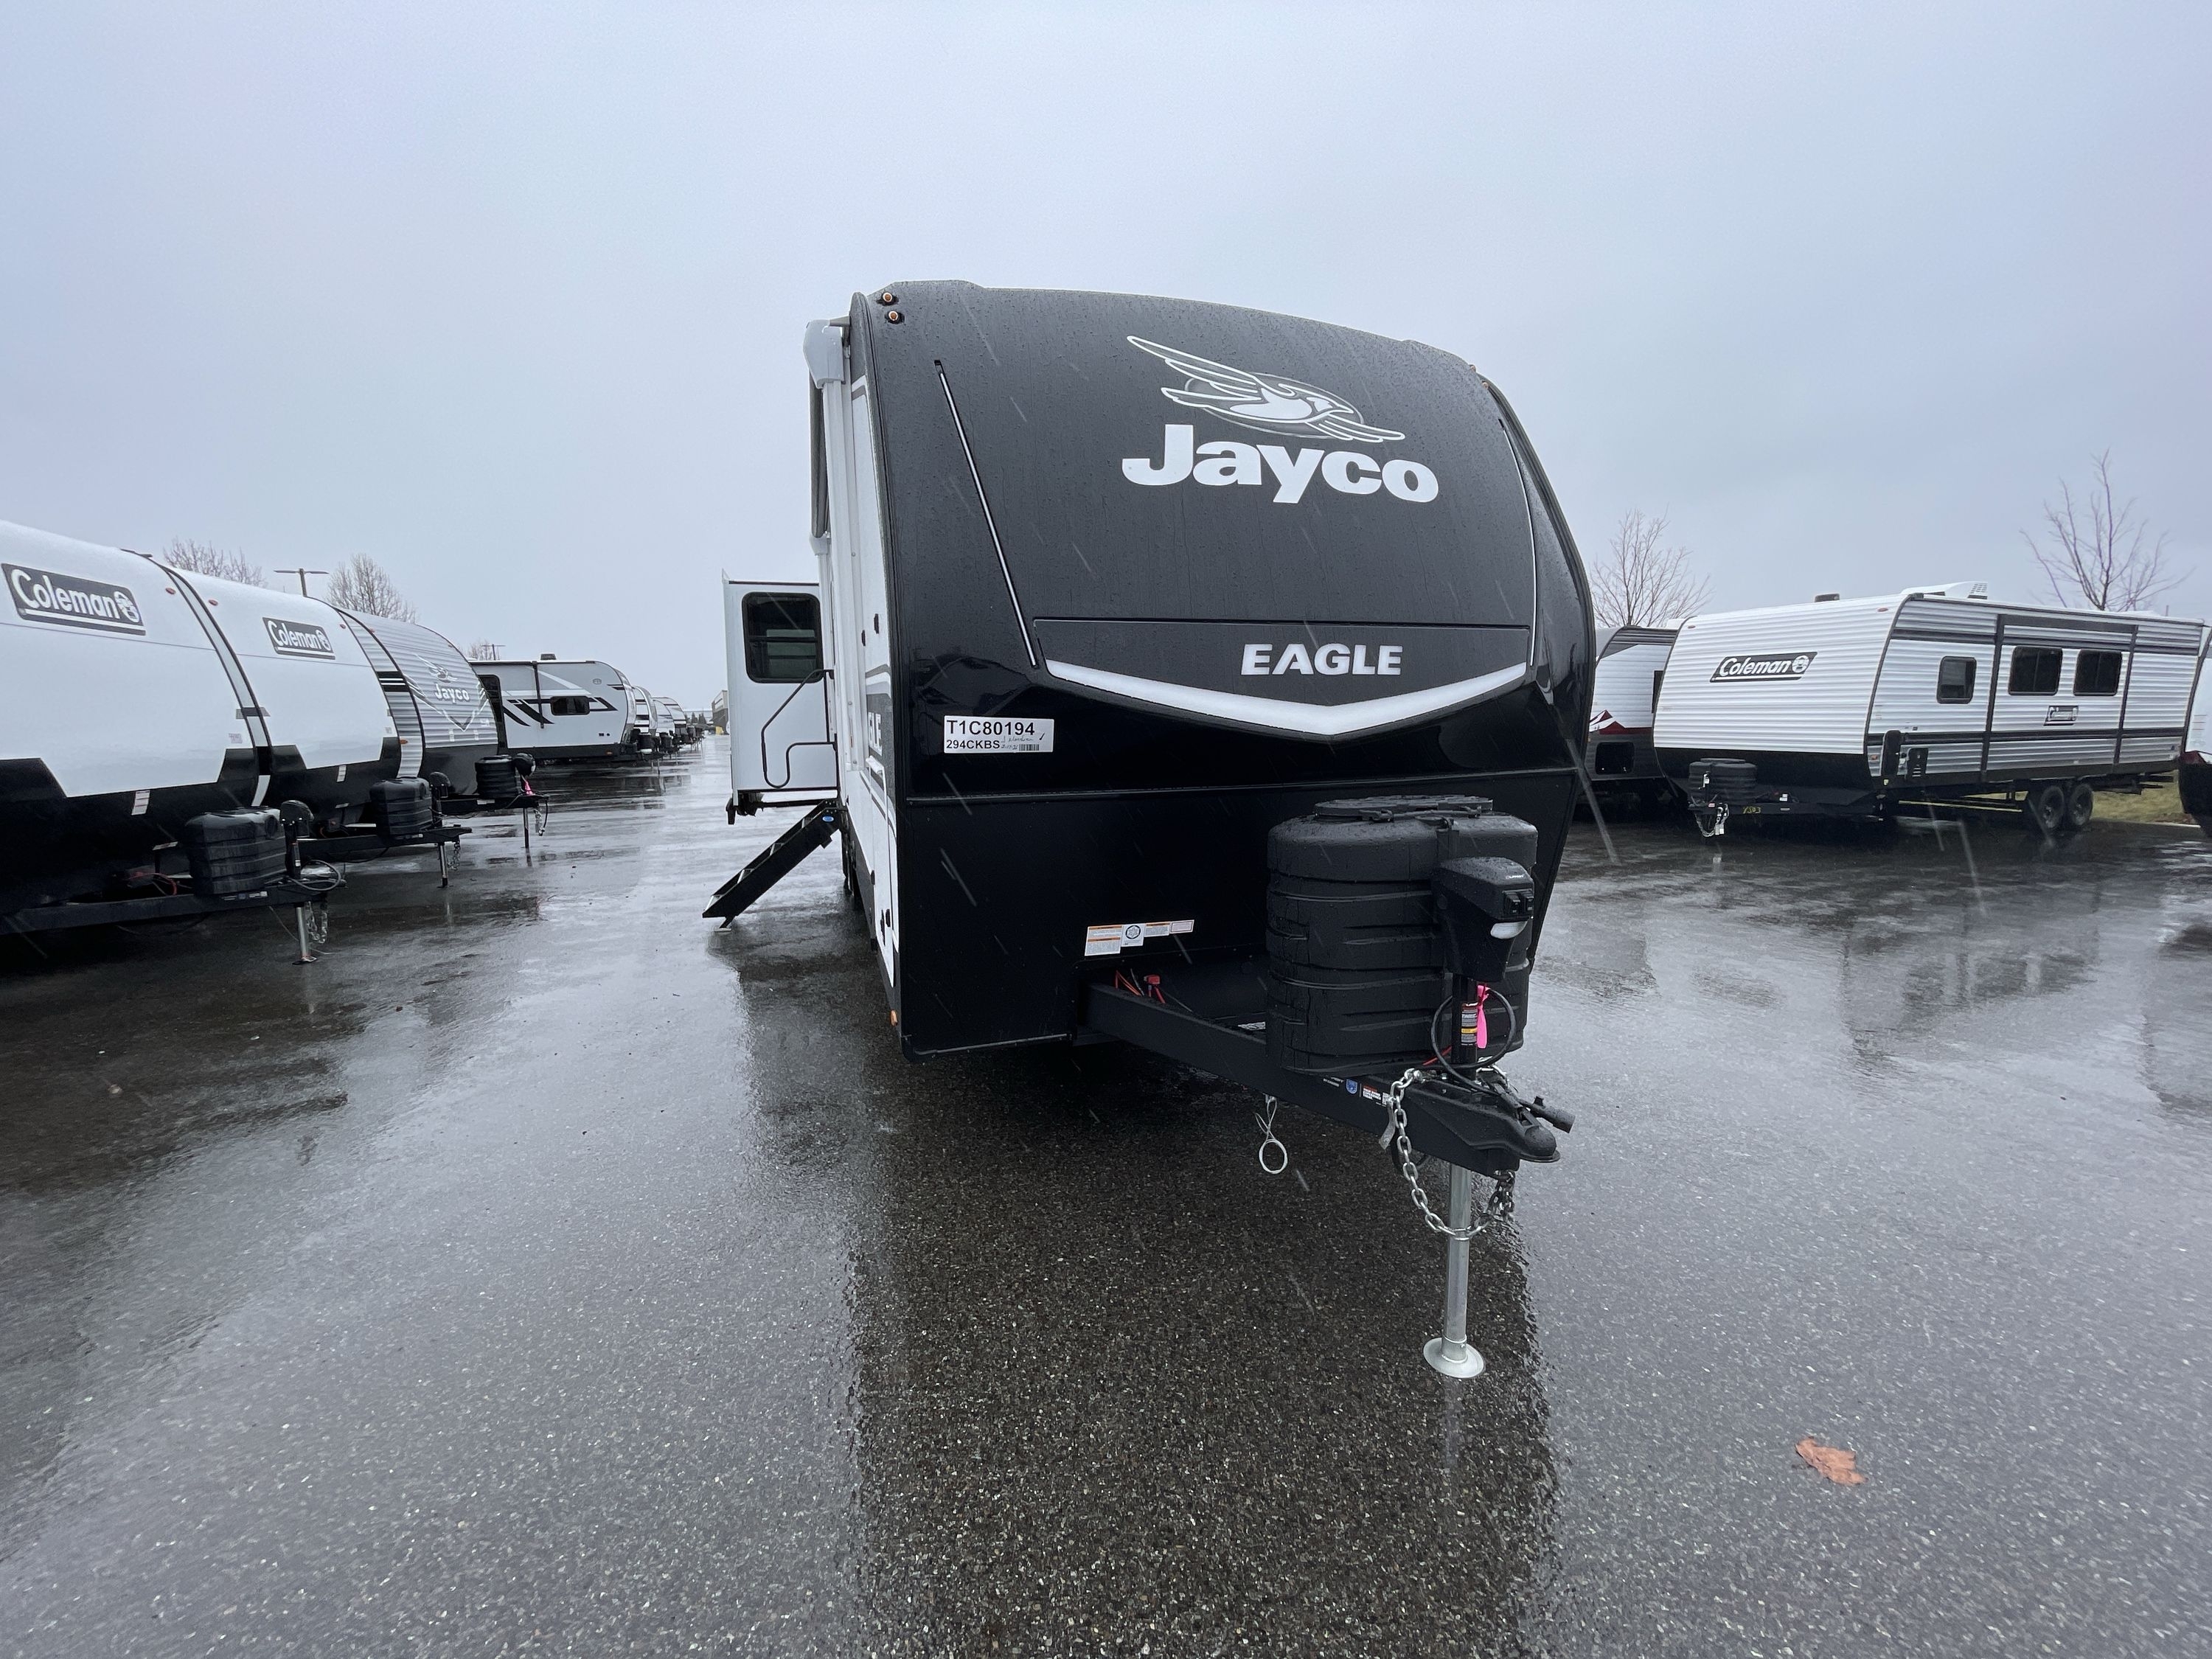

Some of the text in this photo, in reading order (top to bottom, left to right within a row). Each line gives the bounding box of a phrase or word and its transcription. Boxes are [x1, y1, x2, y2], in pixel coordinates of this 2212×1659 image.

[1121, 424, 1439, 504] Jayco
[11, 568, 120, 619] Coleman
[268, 620, 322, 649] Coleman
[1241, 643, 1403, 675] EAGLE
[1719, 657, 1792, 676] Coleman
[434, 684, 470, 703] Jayco
[946, 720, 1035, 736] T1C80194
[946, 740, 1001, 749] 294CKBS
